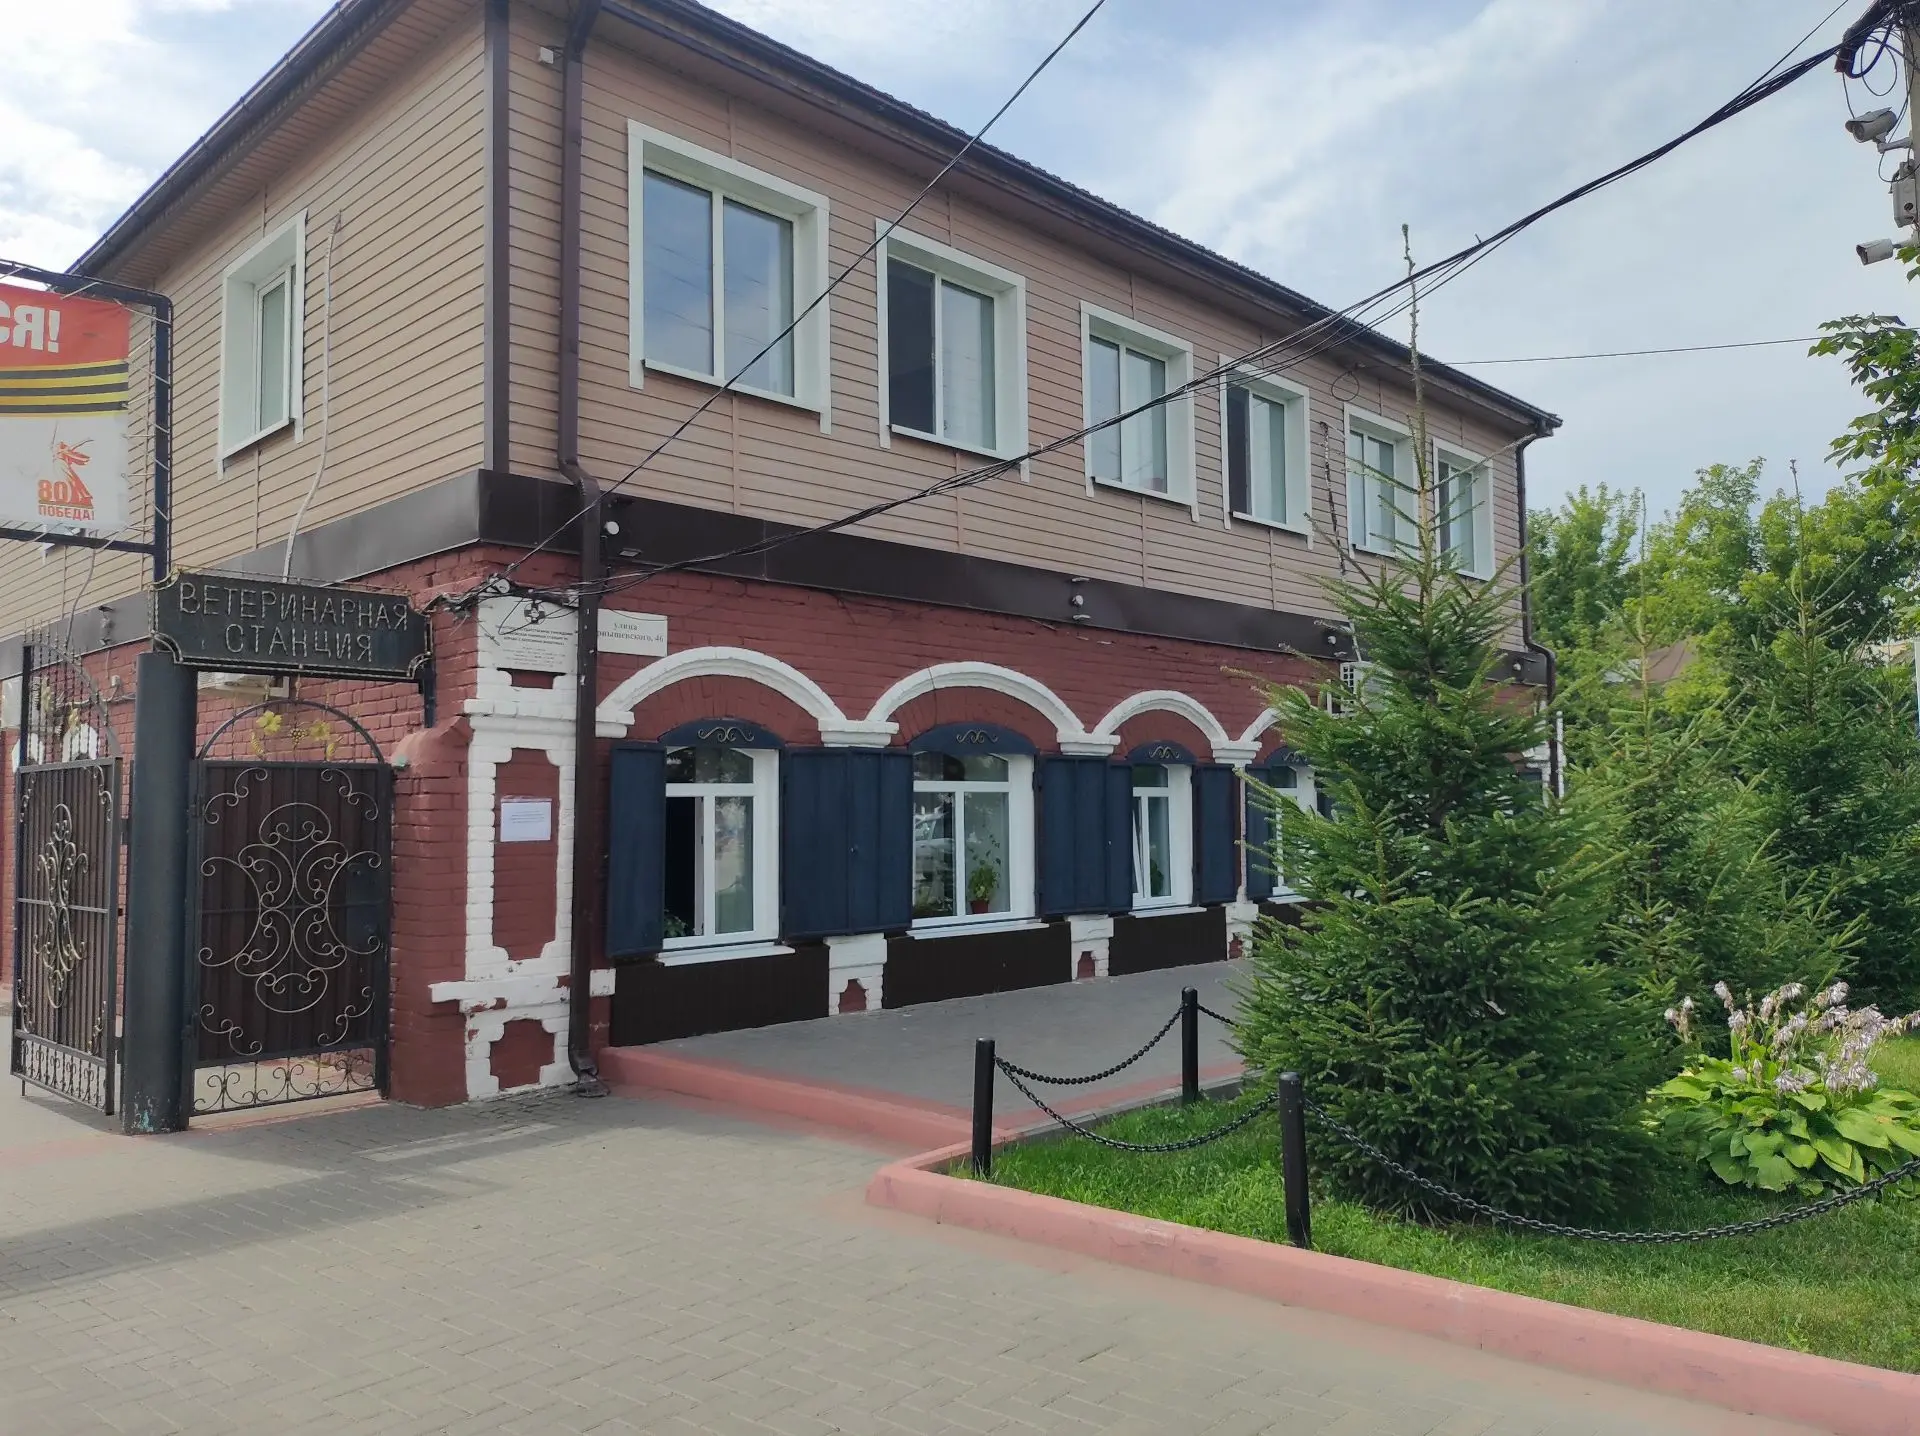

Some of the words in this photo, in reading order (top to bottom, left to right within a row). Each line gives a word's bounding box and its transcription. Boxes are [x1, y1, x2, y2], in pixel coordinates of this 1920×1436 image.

[38, 480, 69, 503] 80
[38, 505, 95, 520] ПОБЕДА!
[179, 582, 408, 632] ВЕТЕРИНАРНАЯ
[225, 623, 372, 662] СТАНЦИЯ
